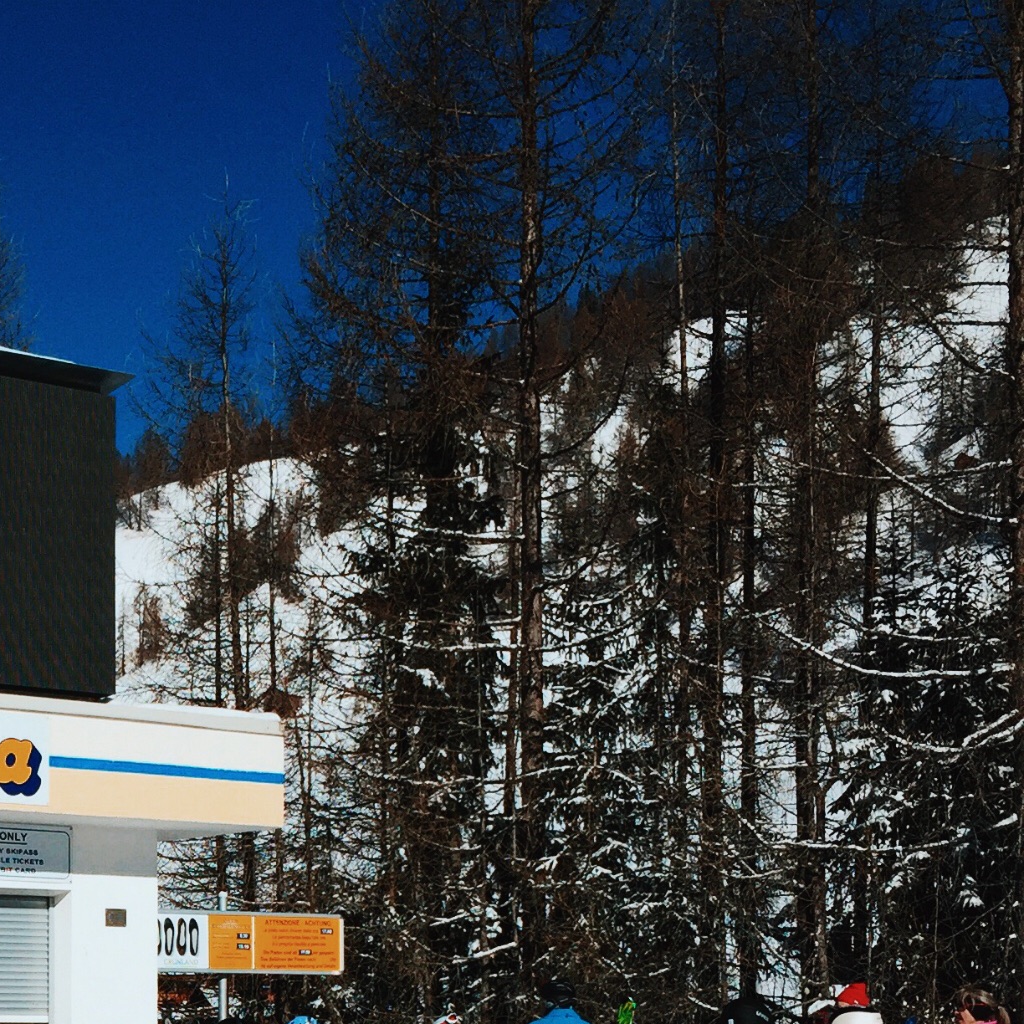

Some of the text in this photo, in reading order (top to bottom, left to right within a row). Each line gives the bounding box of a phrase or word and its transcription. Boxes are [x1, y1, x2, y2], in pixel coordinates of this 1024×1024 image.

[0, 831, 28, 842] ONLY
[6, 848, 38, 856] SKIPASS
[12, 857, 44, 866] TICKETS
